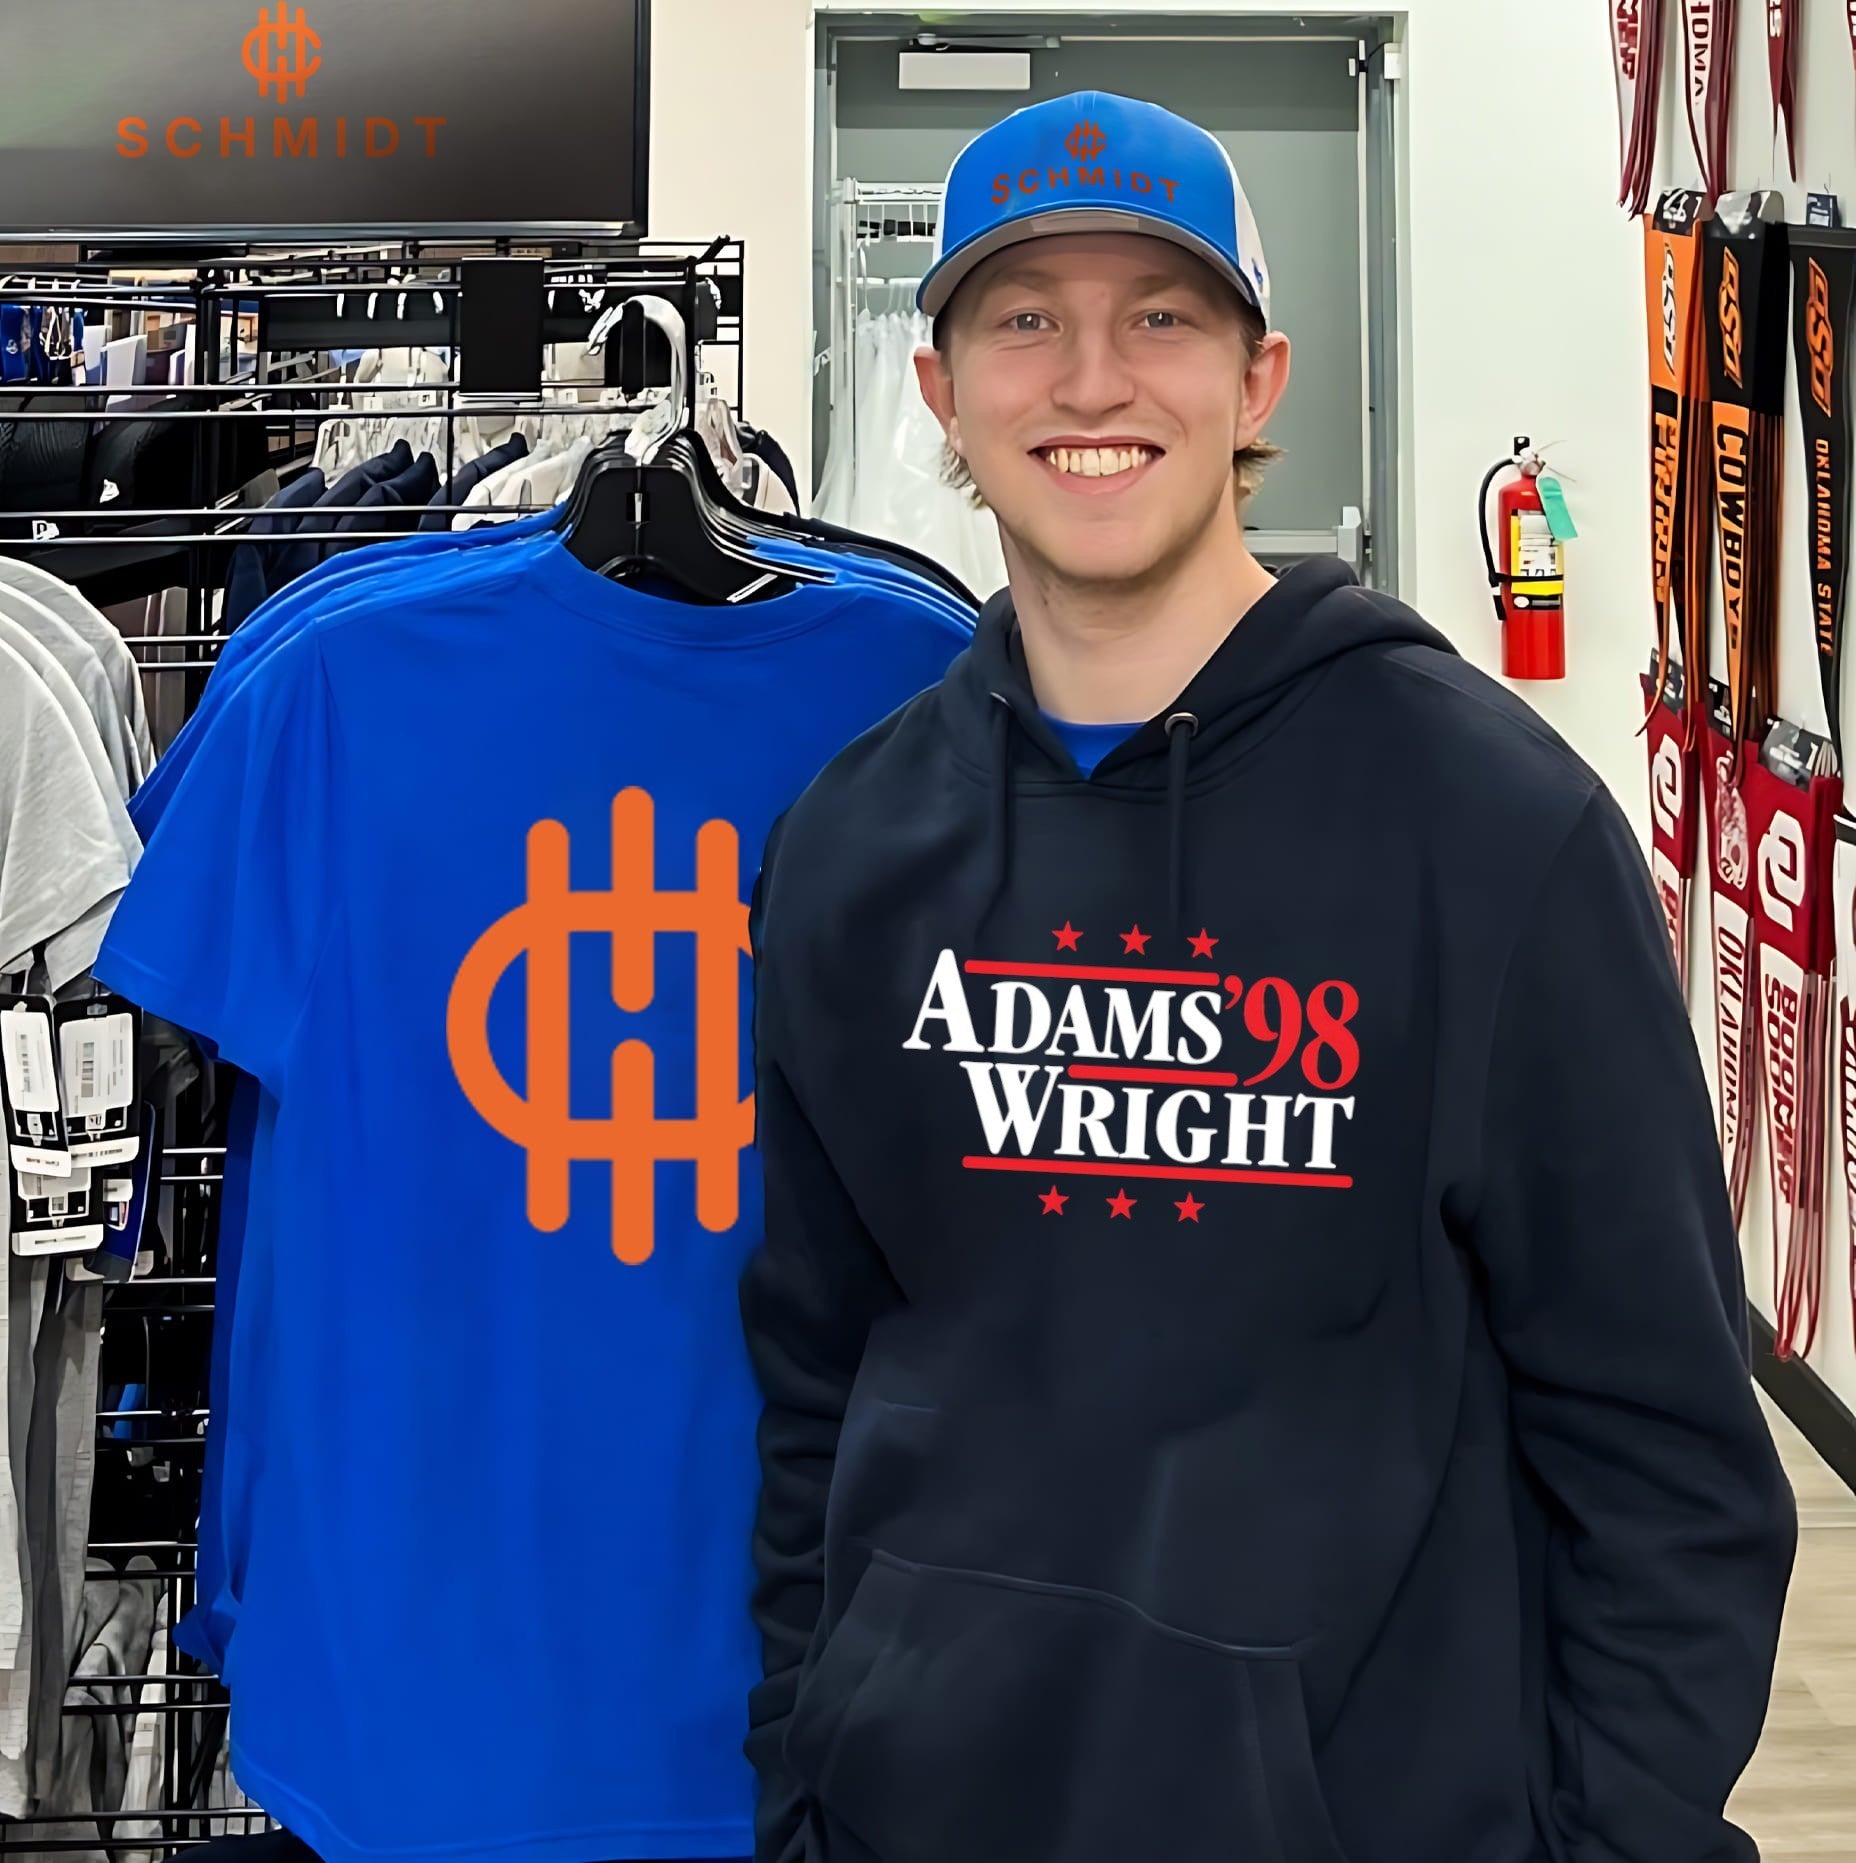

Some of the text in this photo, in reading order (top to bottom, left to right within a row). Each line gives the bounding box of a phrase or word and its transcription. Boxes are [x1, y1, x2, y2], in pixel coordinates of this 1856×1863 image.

[116, 117, 447, 158] SCHMIDT
[991, 166, 1179, 204] SCHMIDT
[1816, 438, 1834, 657] OKLAHOMA STATE
[902, 949, 1361, 1091] ADAMS '98
[1718, 925, 1744, 1144] OKLAHOMA
[959, 1061, 1355, 1168] WRIGHT
